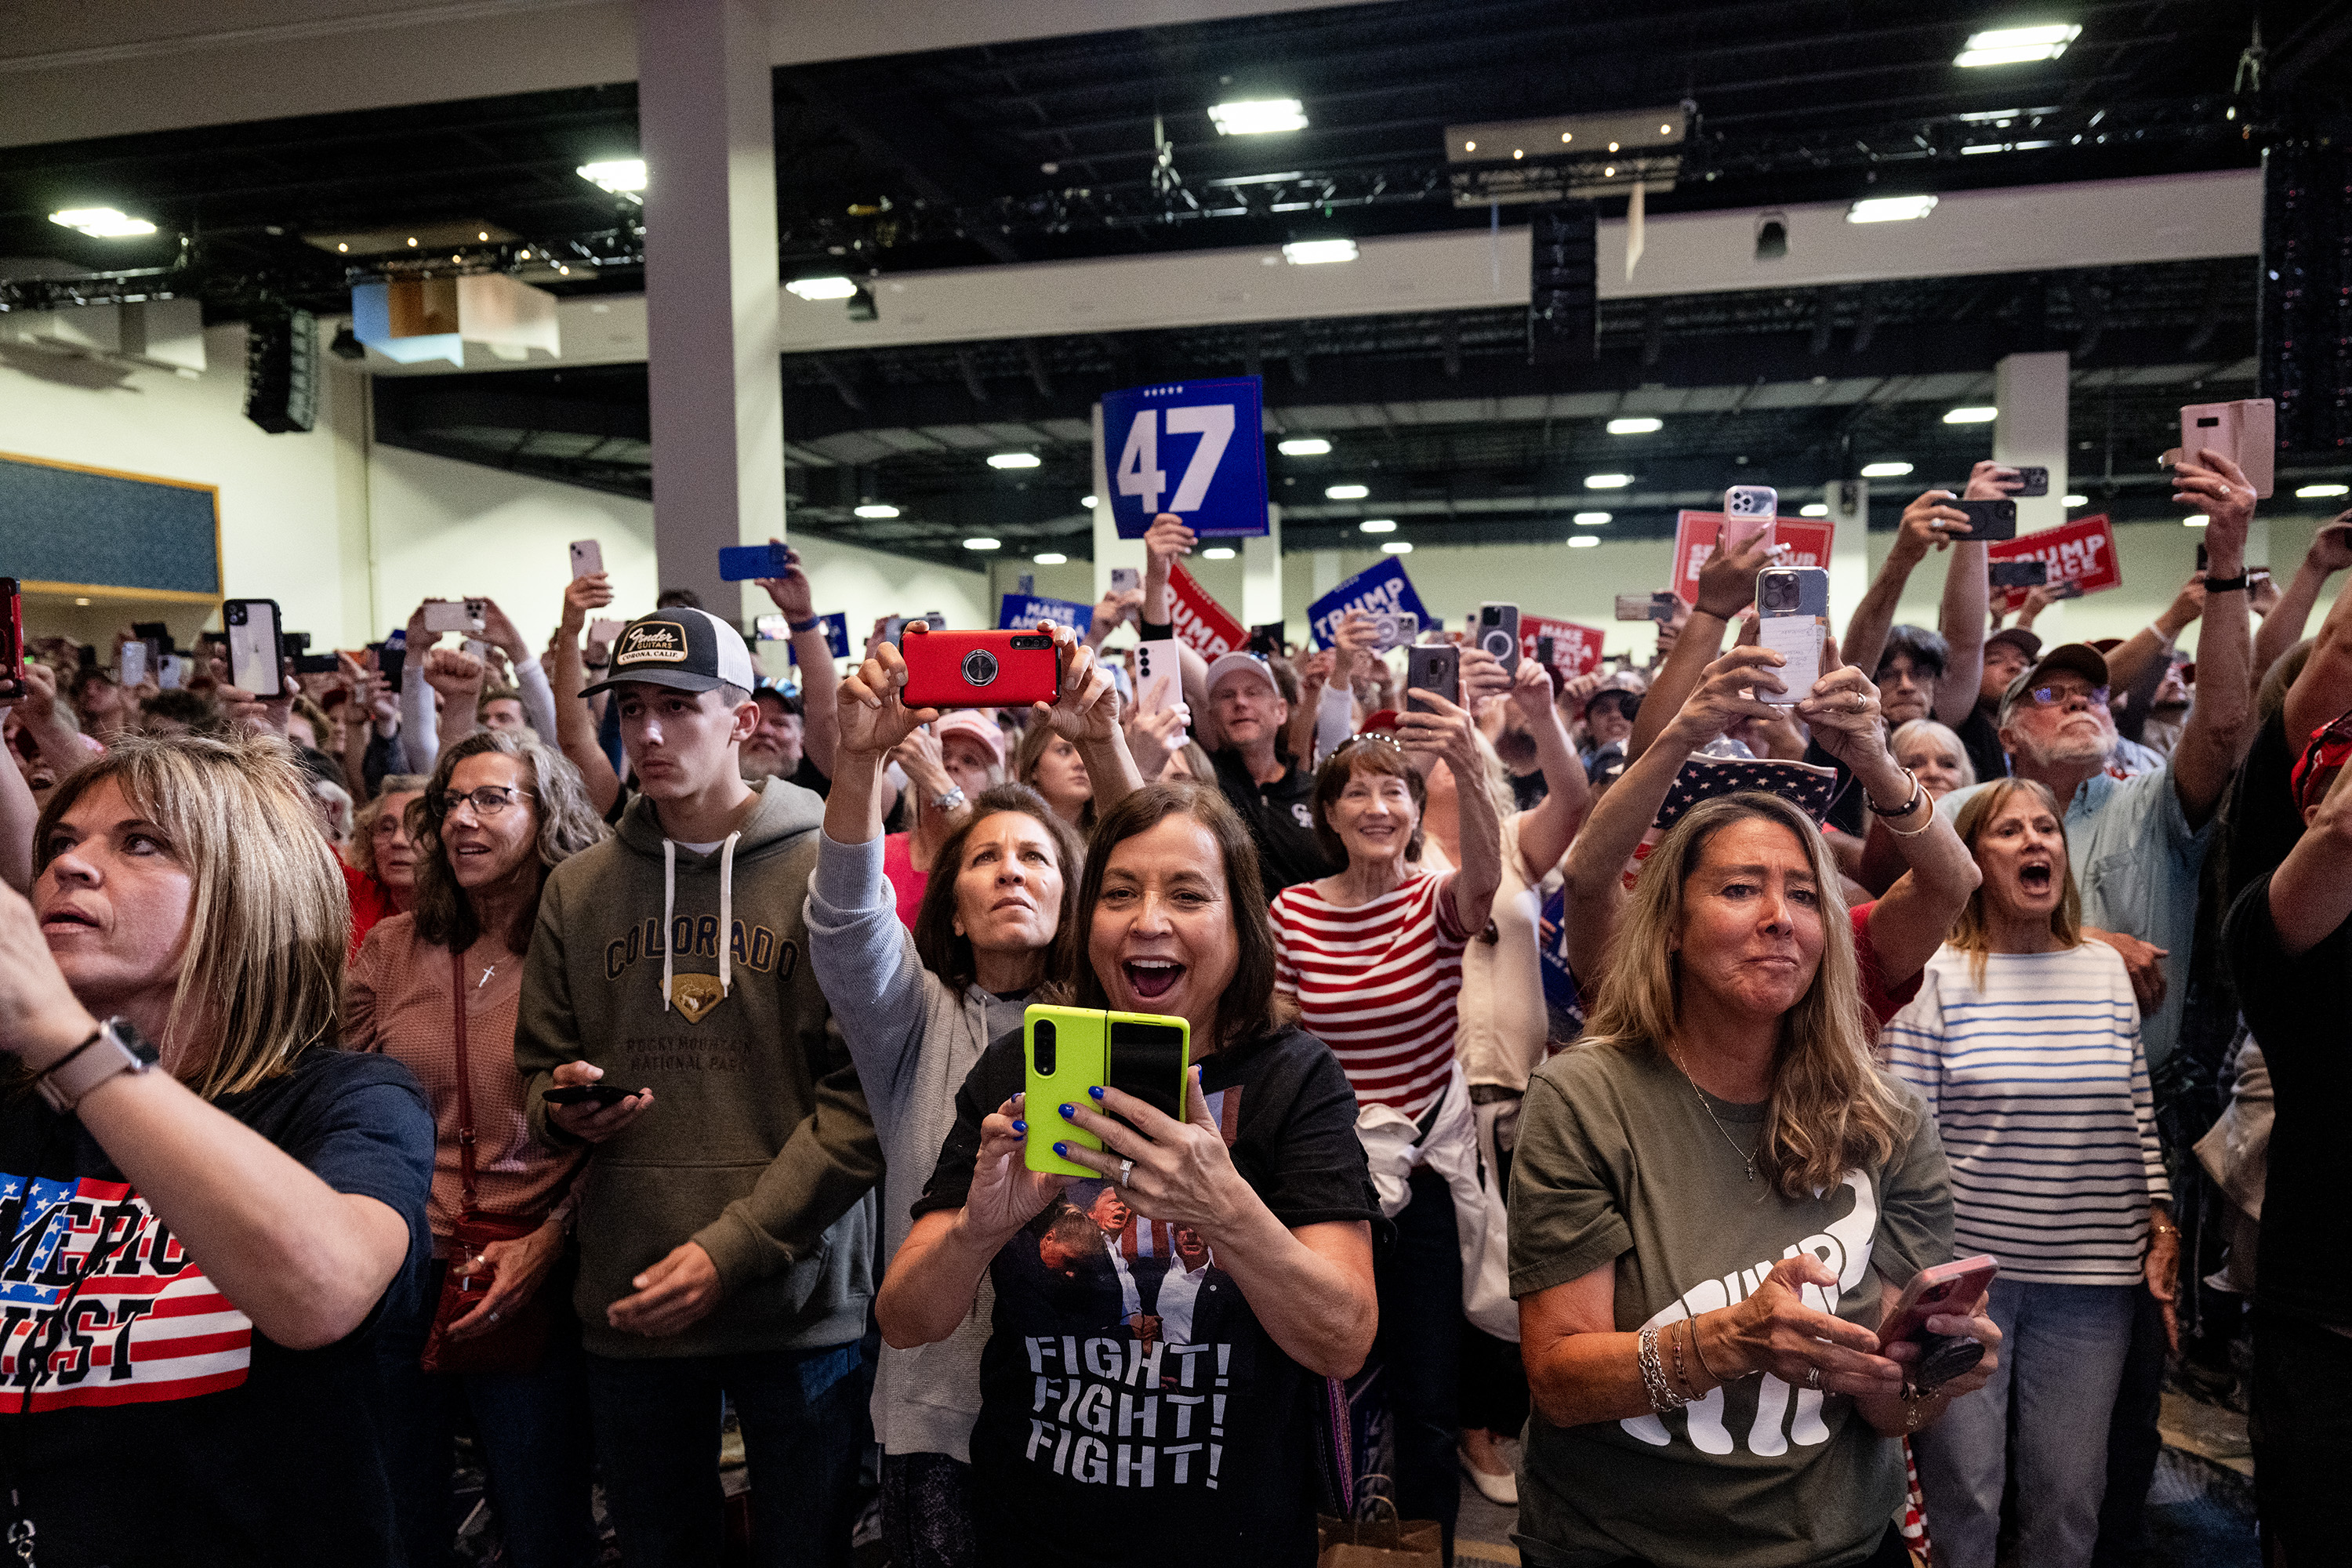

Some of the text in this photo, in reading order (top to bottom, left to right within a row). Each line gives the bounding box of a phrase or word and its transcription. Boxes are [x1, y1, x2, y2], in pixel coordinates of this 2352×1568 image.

[1116, 404, 1236, 514] 47
[1025, 601, 1075, 620] MAKE
[628, 627, 679, 652] Fender
[637, 641, 673, 650] GUITARS
[654, 650, 678, 659] CALIF.
[604, 914, 800, 982] COLORADO
[626, 1036, 673, 1053] ROCKY
[630, 1055, 748, 1073] NATIONAL PARK
[1025, 1335, 1232, 1389] FIGHT!
[1032, 1375, 1227, 1439] FIGHT!
[1025, 1417, 1223, 1490] FIGHT!
